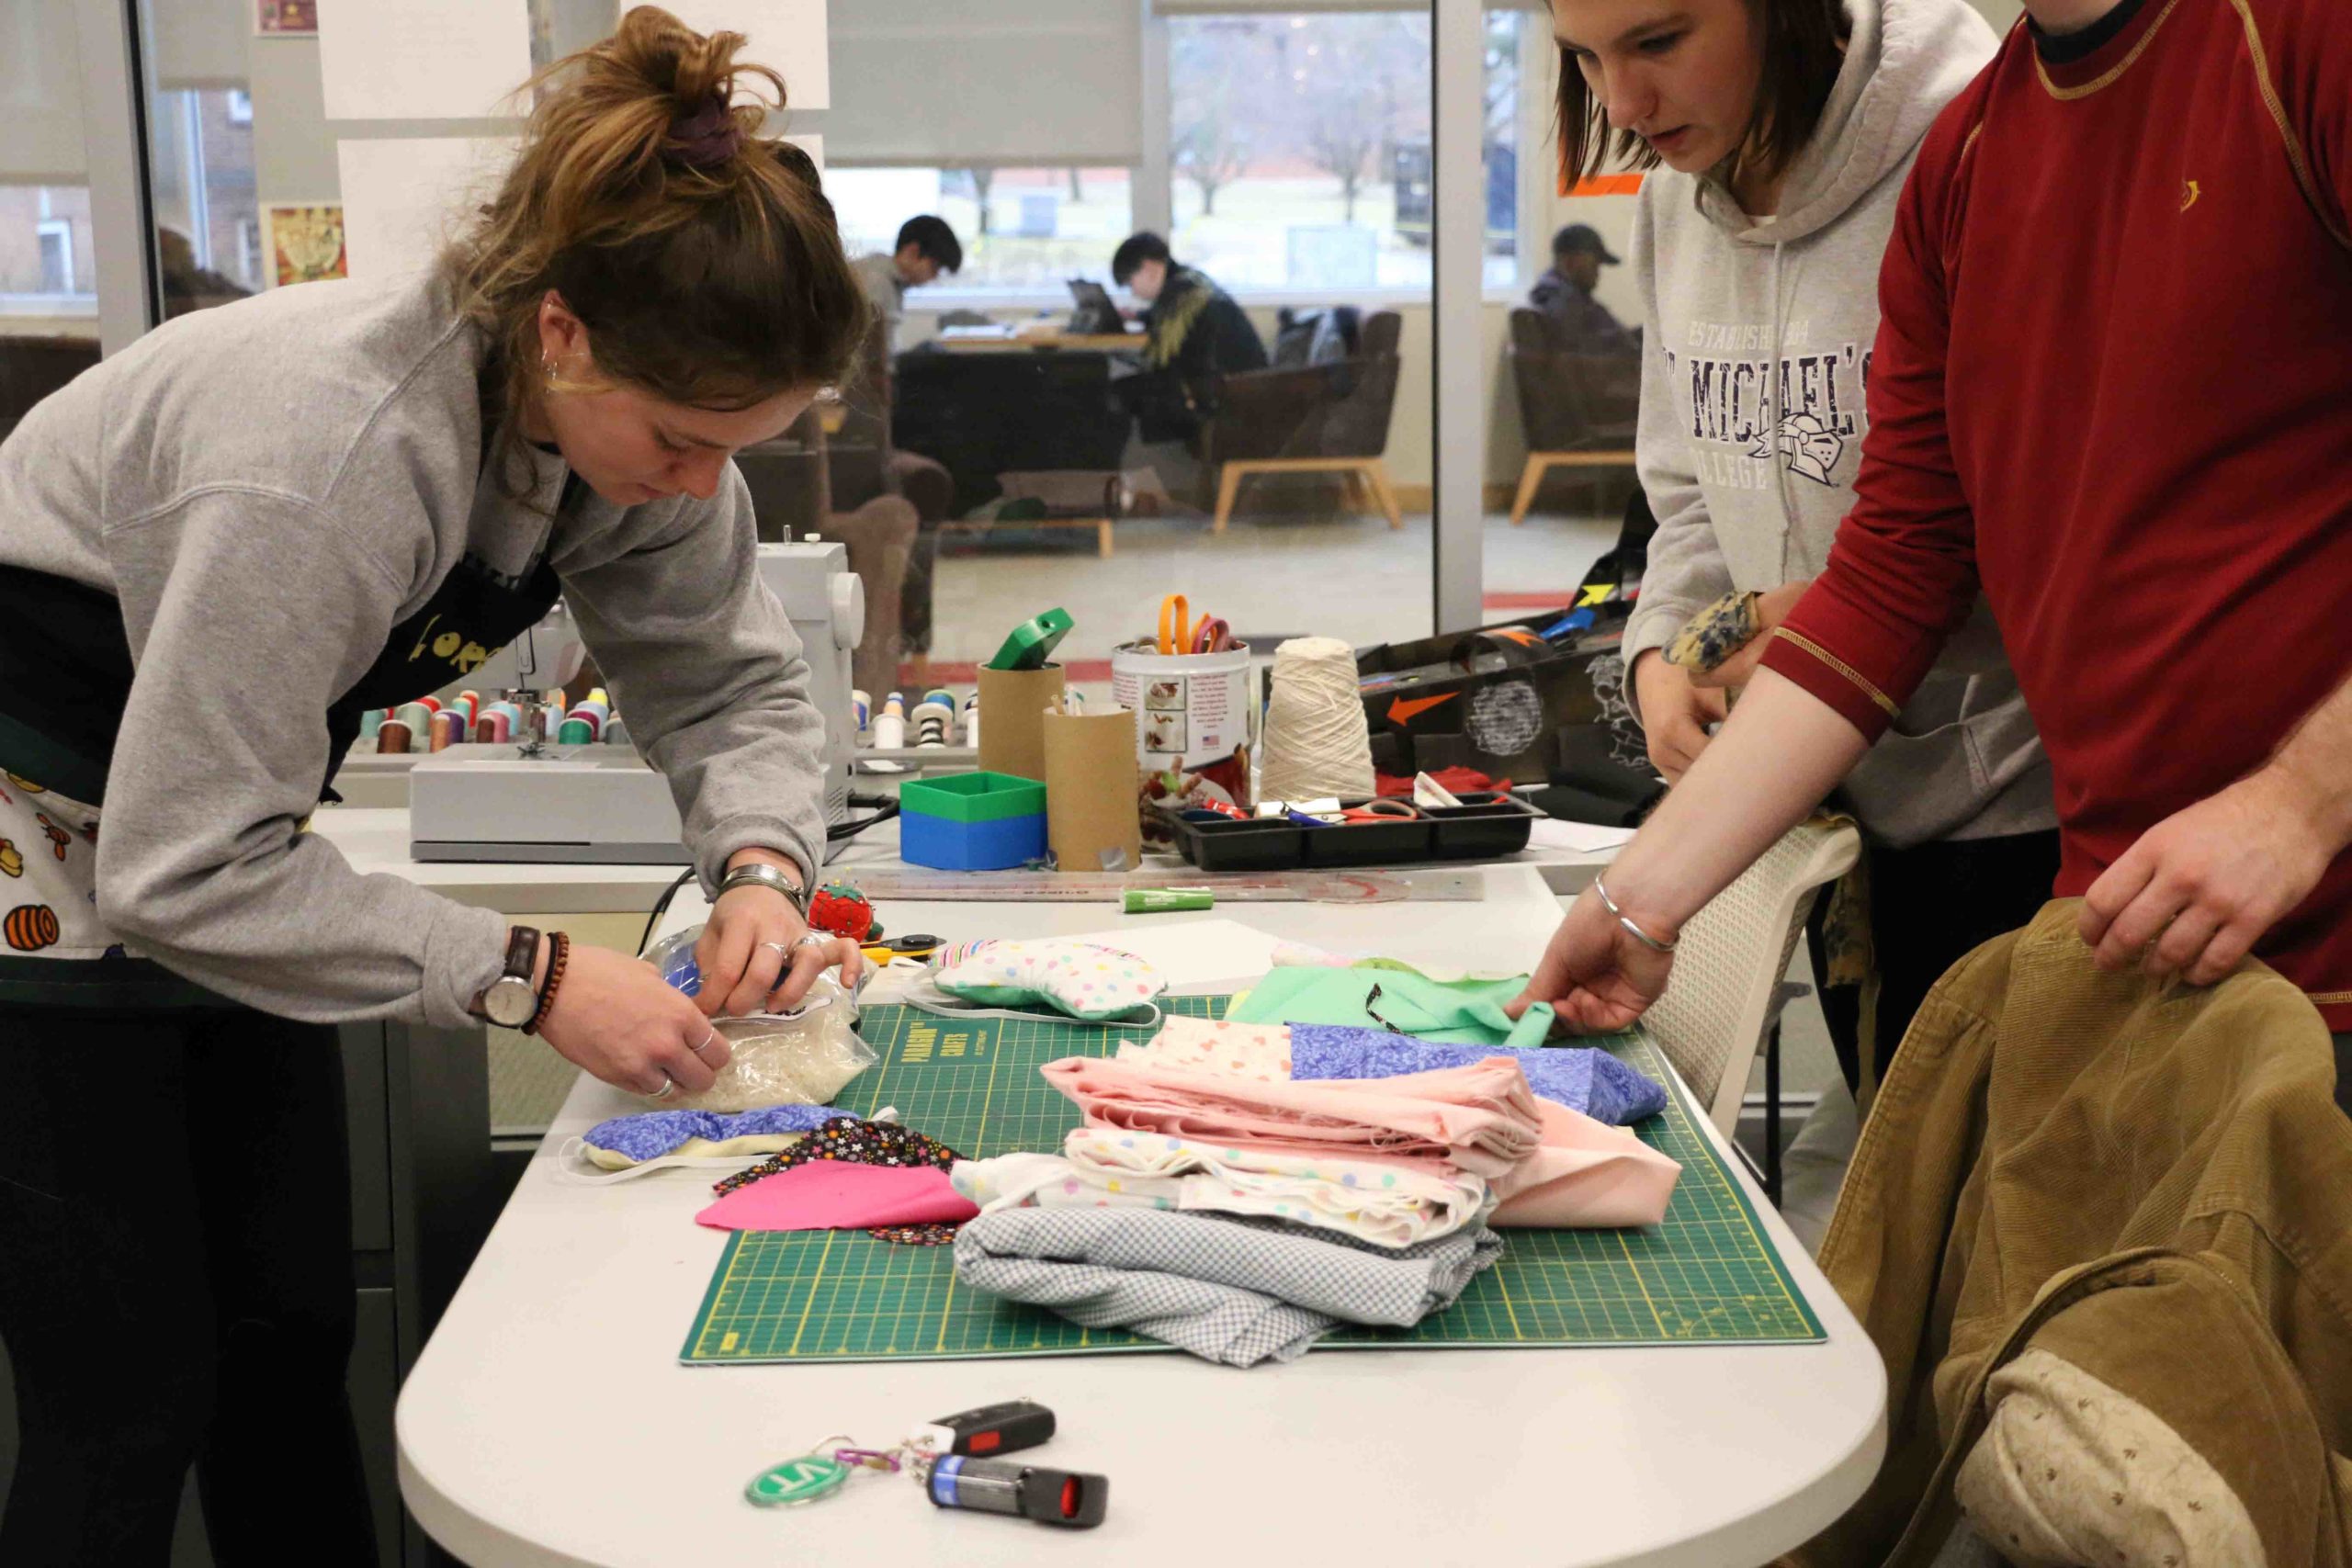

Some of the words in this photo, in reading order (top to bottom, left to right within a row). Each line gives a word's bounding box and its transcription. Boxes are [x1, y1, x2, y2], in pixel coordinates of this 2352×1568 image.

[1687, 321, 1775, 350] ESTABLISH
[1694, 448, 1767, 490] LLEGE
[939, 1033, 969, 1056] CRAFTS
